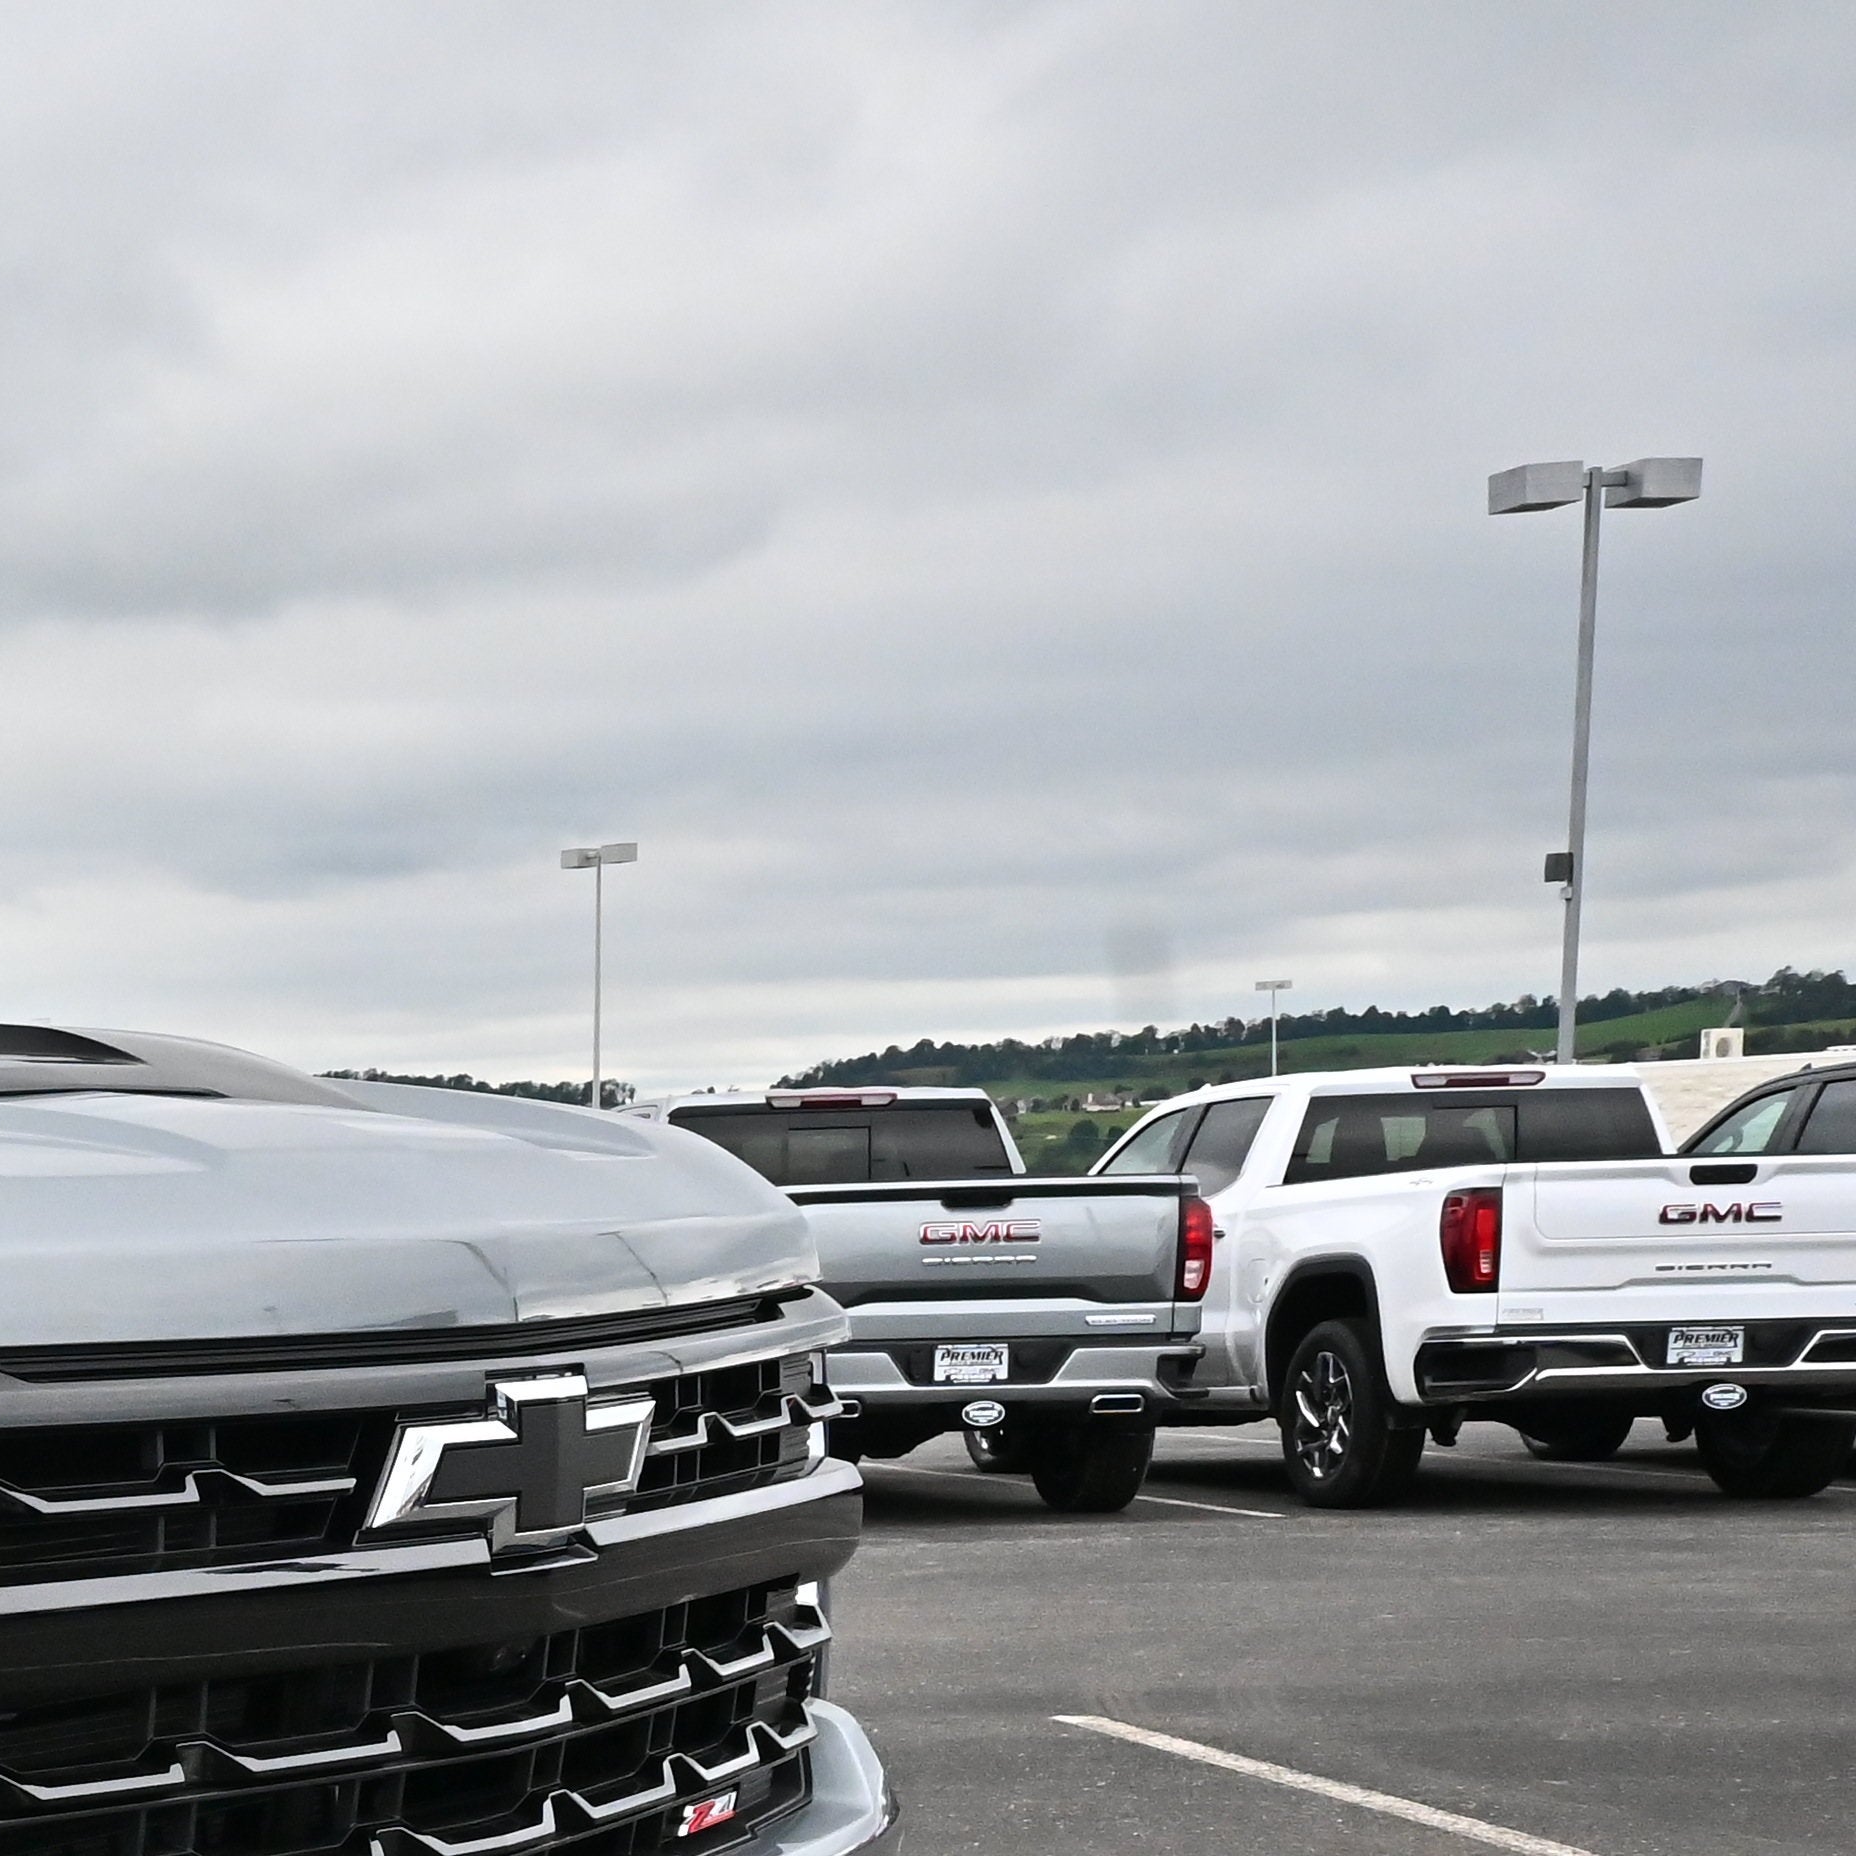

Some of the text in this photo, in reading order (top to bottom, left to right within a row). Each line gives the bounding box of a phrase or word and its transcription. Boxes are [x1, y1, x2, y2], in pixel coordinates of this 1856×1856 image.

[1658, 1201, 1783, 1225] GMC
[919, 1218, 1041, 1246] GMC
[921, 1255, 1038, 1266] SIERRA
[1655, 1262, 1773, 1272] SIERRA
[1672, 1330, 1740, 1348] PREMIER
[940, 1347, 1004, 1365] PREMIER
[677, 1790, 738, 1837] Z71
